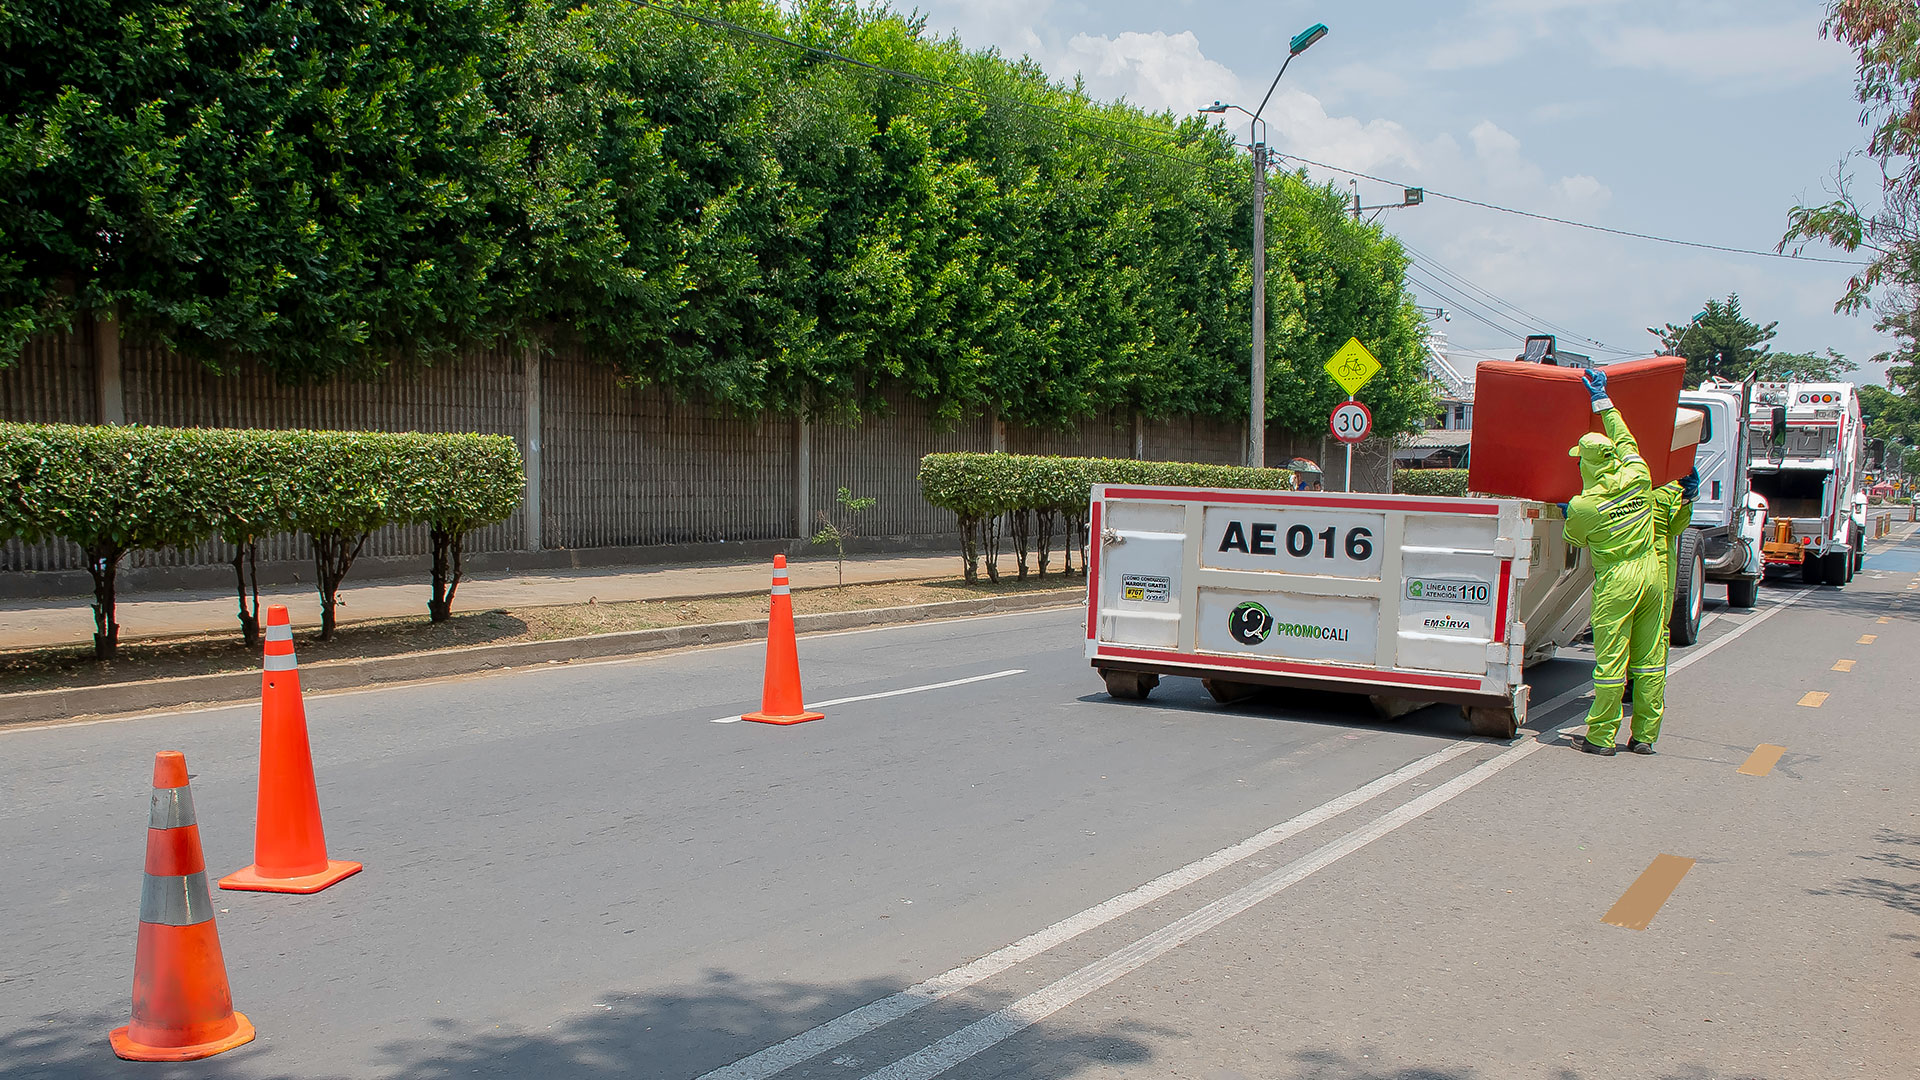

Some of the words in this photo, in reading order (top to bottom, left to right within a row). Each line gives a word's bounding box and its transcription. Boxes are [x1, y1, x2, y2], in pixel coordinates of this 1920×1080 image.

[1338, 413, 1364, 432] 30
[1609, 497, 1644, 520] PROMO
[1218, 521, 1277, 556] AE
[1286, 524, 1373, 561] 016
[1425, 591, 1457, 599] ATENCIÓN
[1426, 583, 1446, 592] LÍNEA
[1458, 585, 1487, 601] 110
[1423, 615, 1470, 629] EMSIRVA
[1277, 623, 1349, 642] PROMOCALI
